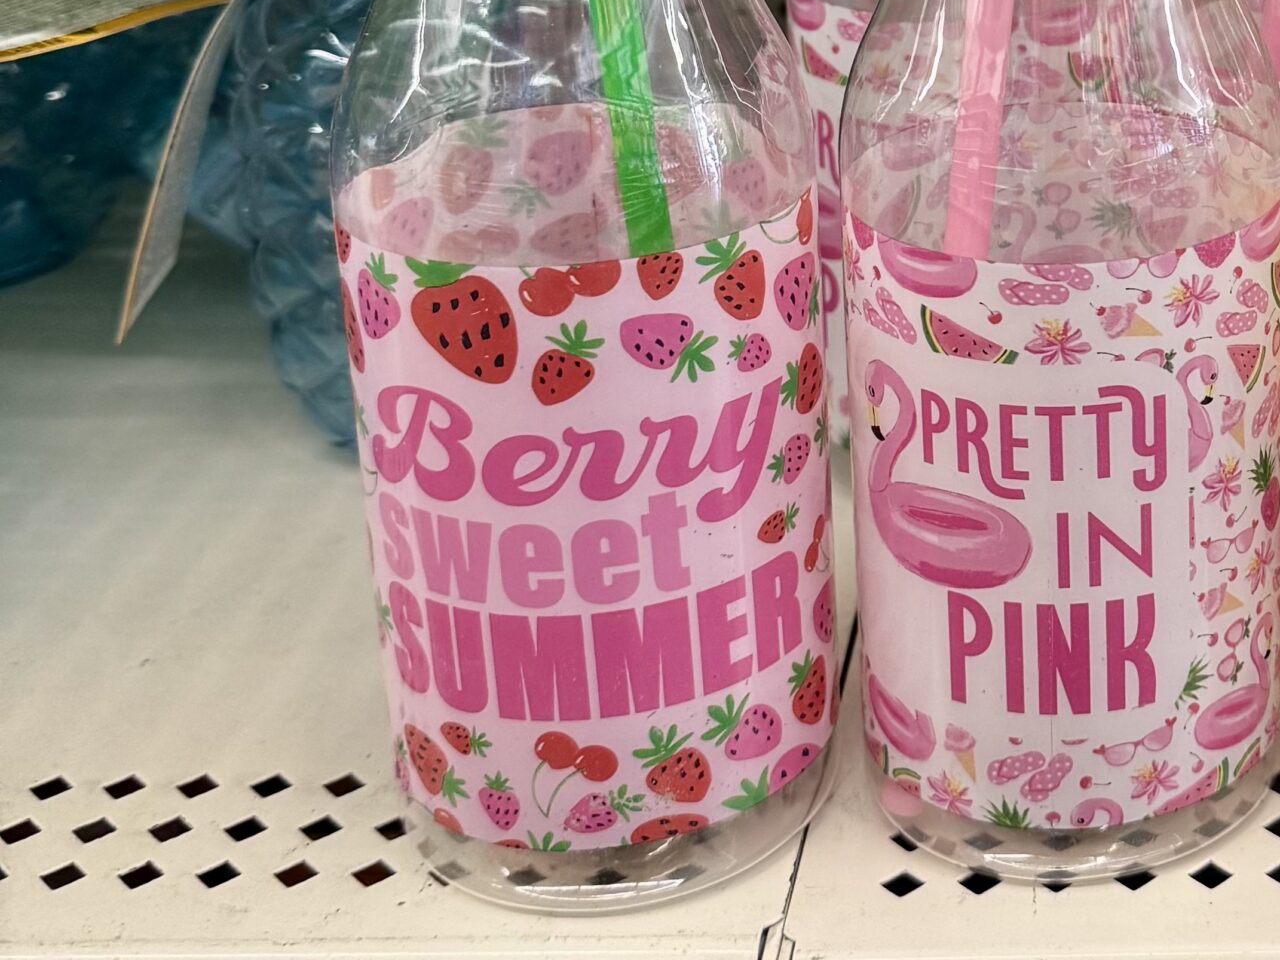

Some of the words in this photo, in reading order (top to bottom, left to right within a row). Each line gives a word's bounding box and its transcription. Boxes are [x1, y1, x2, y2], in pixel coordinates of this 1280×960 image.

[374, 378, 783, 523] Berry
[920, 385, 1168, 500] PRETTY
[381, 493, 689, 608] sweet
[1057, 502, 1152, 589] IN
[391, 551, 802, 720] SUMMER
[948, 590, 1157, 715] PINK
